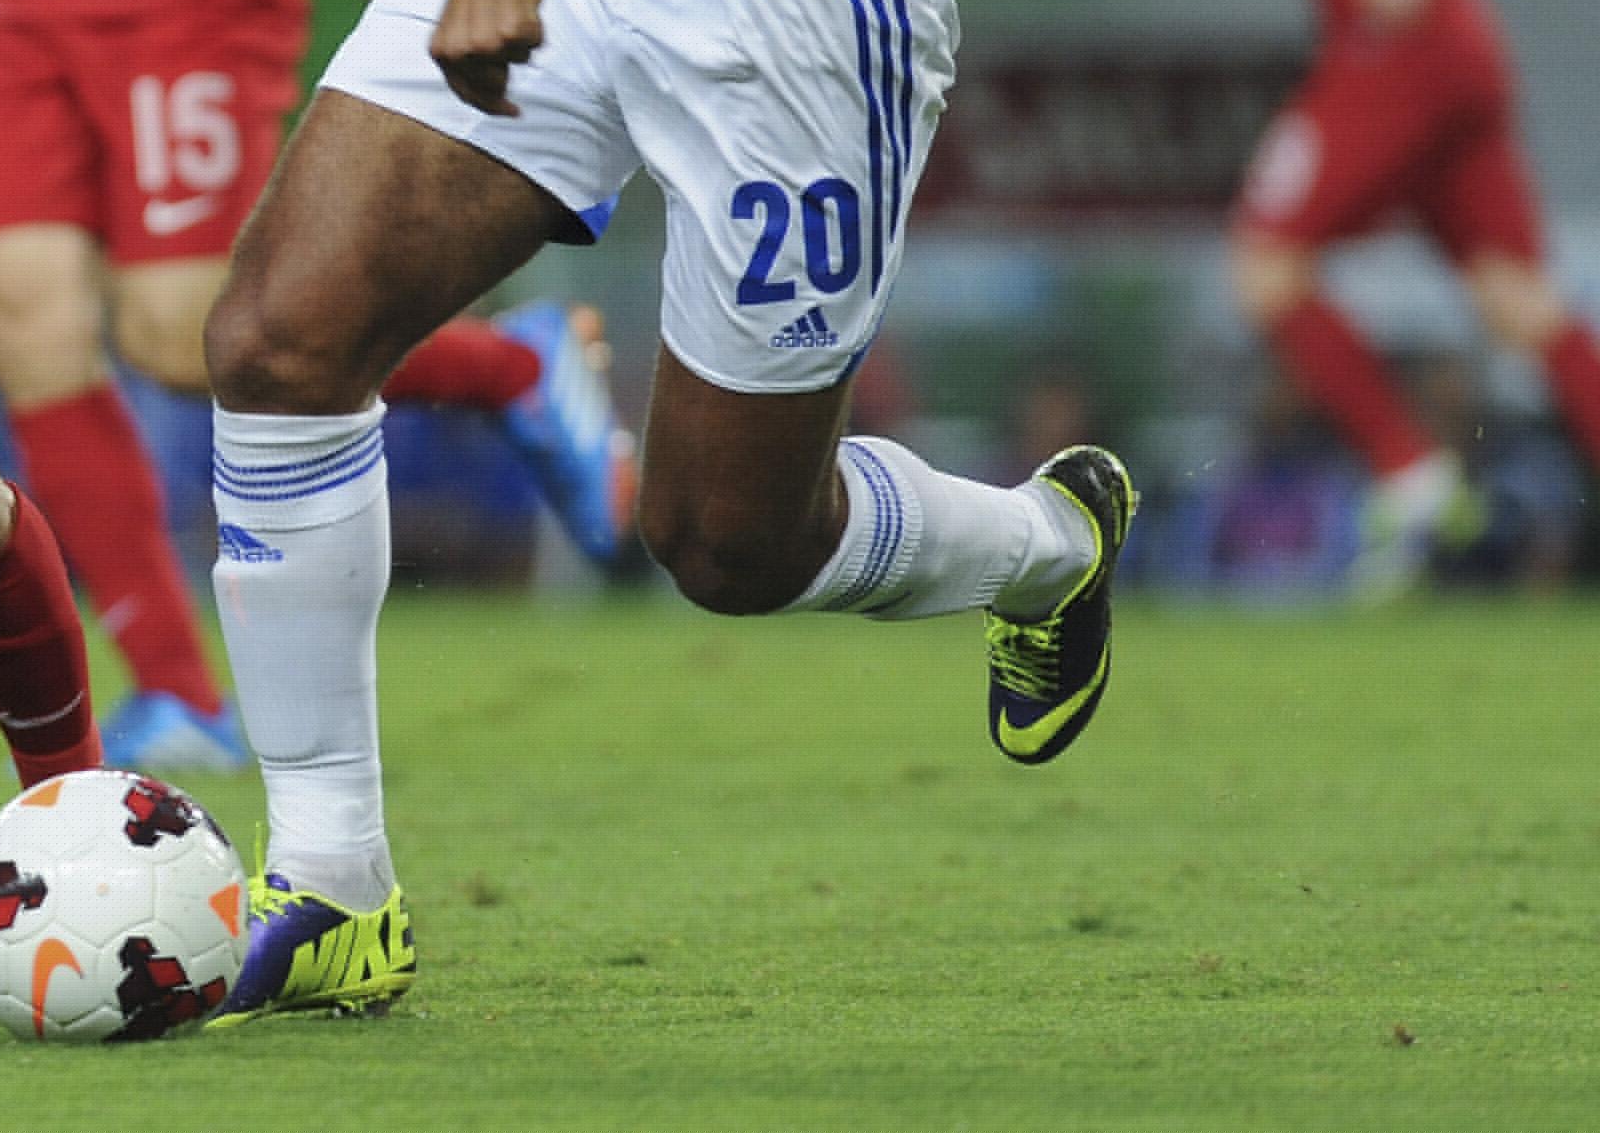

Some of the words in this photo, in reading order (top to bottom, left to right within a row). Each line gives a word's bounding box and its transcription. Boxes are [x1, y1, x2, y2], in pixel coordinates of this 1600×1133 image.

[129, 70, 242, 193] 15
[730, 177, 861, 306] 20
[770, 330, 839, 348] adidas
